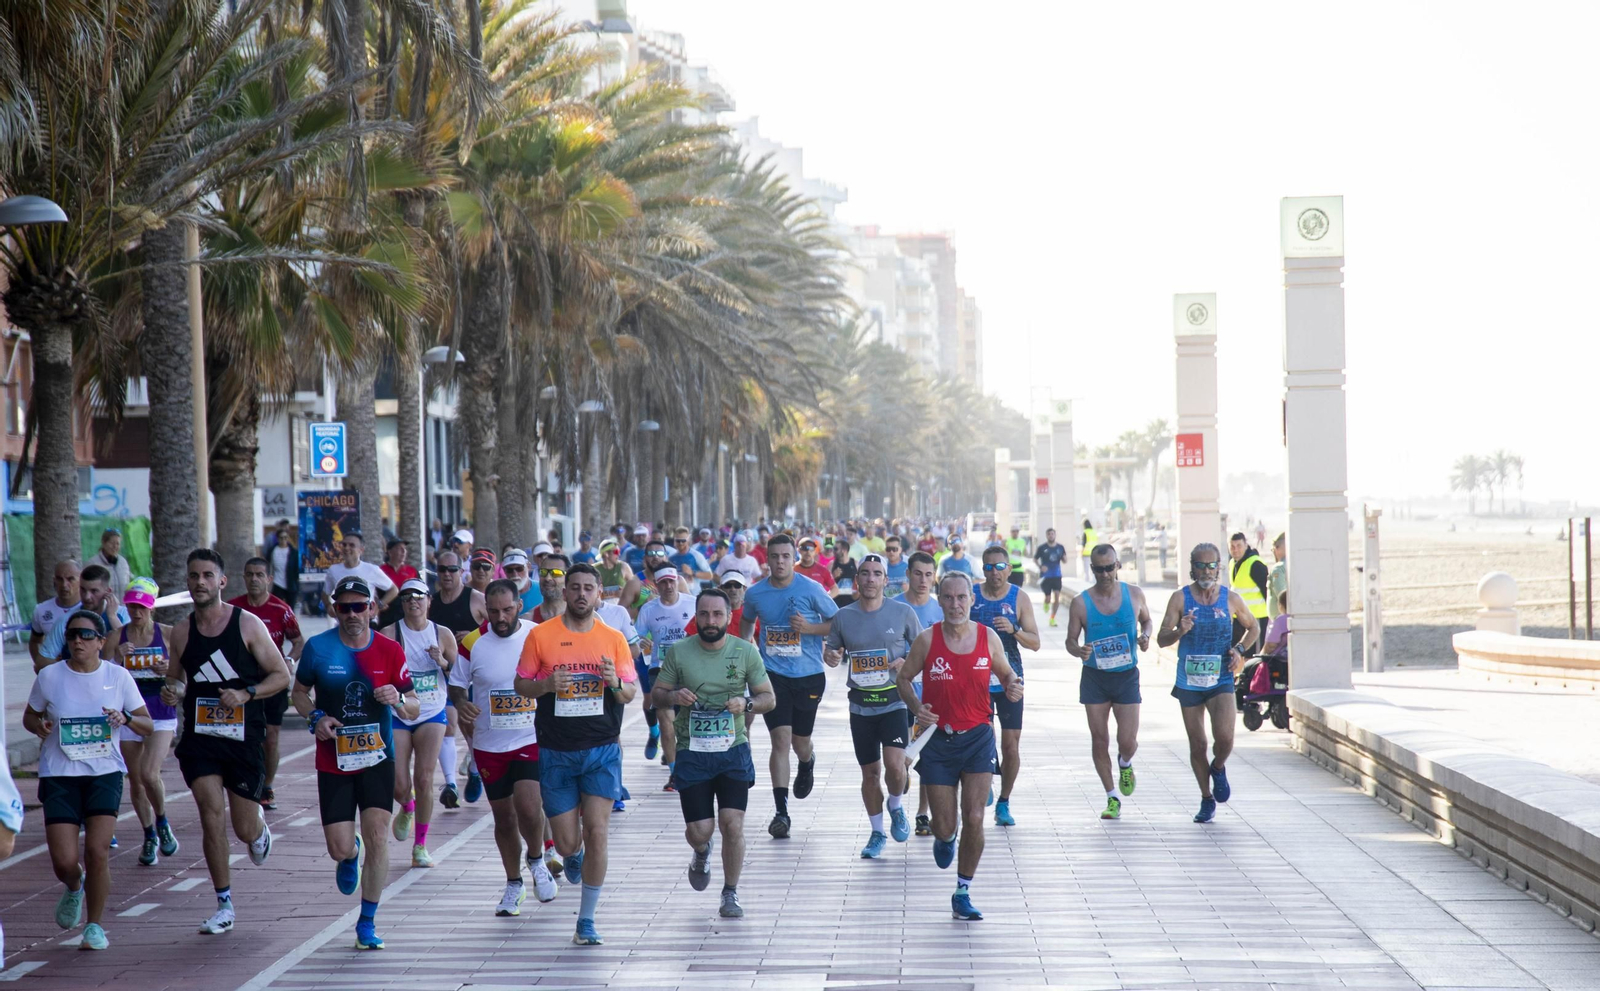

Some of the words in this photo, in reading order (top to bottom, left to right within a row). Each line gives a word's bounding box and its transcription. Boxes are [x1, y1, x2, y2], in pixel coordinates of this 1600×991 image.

[306, 495, 355, 507] CHICAGO
[769, 632, 797, 642] 2294
[1101, 642, 1123, 653] 846
[856, 656, 884, 669] 1988
[1193, 661, 1215, 671] 712
[930, 672, 954, 681] Sevilla
[495, 696, 531, 709] 2323
[206, 707, 234, 719] 262
[71, 724, 103, 738] 556
[694, 719, 730, 732] 2212
[346, 733, 376, 748] 766
